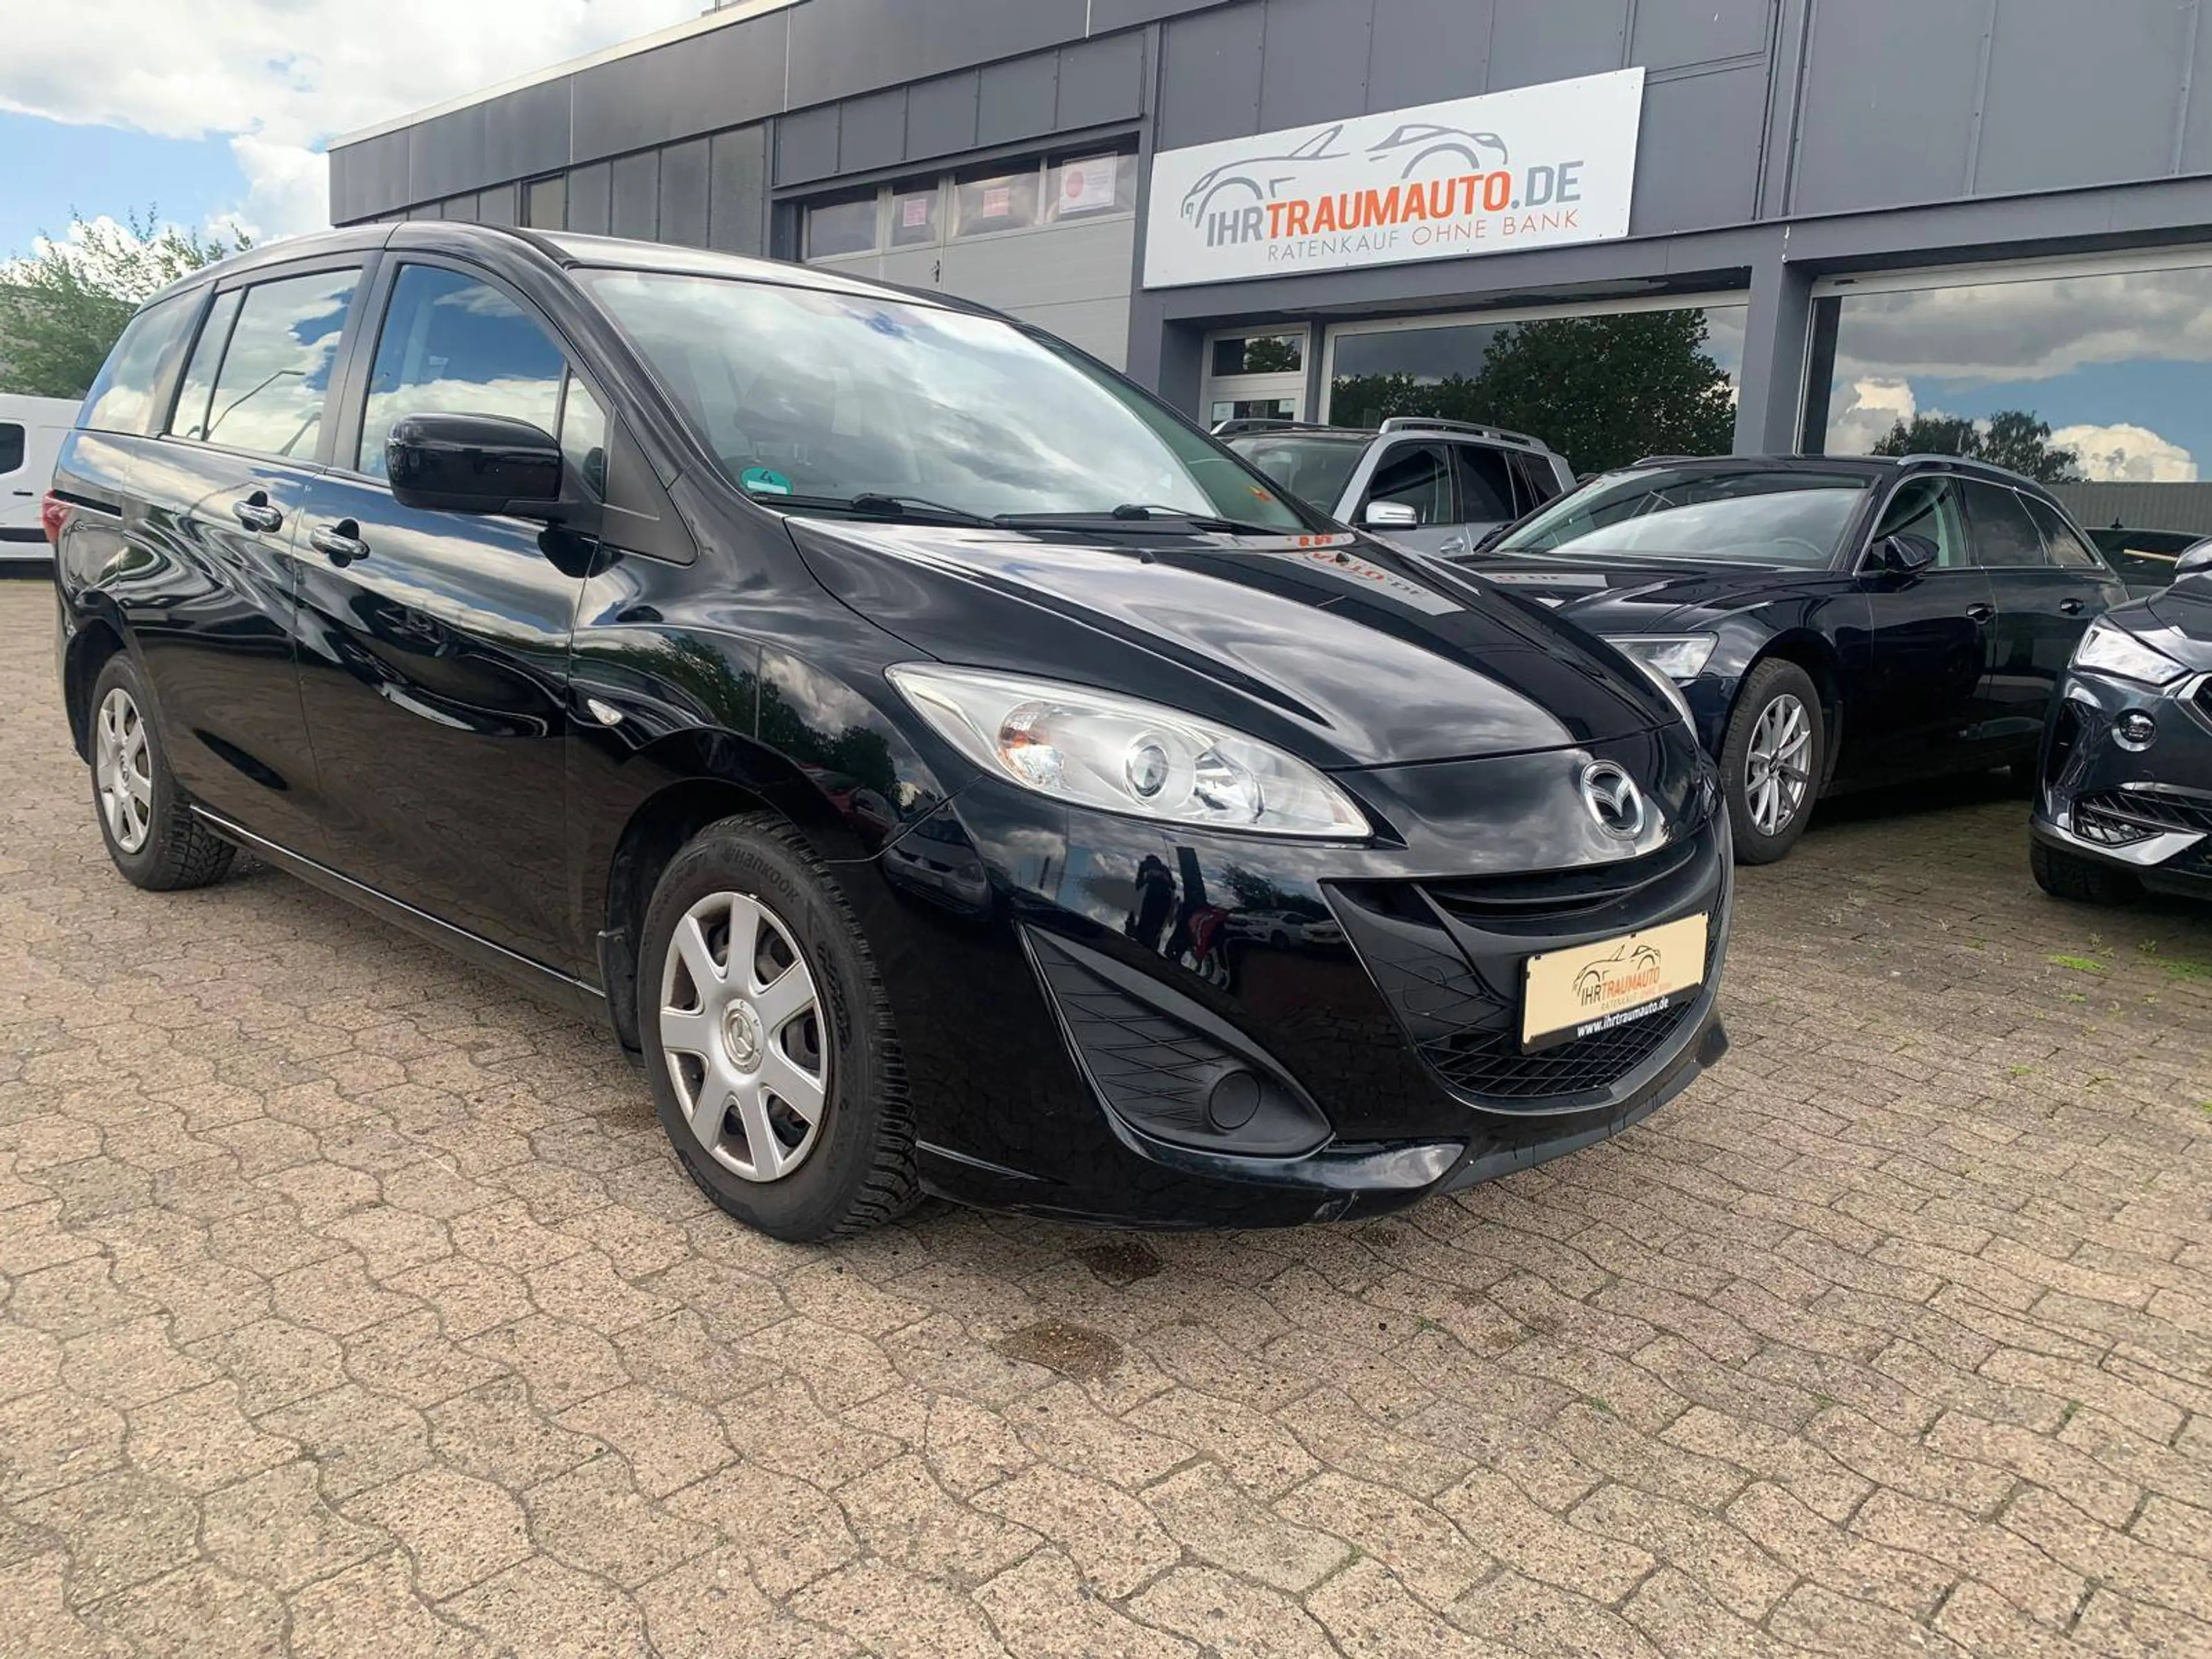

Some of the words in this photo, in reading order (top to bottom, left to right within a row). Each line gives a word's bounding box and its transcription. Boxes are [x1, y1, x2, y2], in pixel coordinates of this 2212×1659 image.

[1206, 160, 1584, 247] IHRTRAUMAUTO.DE
[1268, 230, 1399, 262] RATENKAUF
[1412, 219, 1487, 245] OHNE
[1502, 208, 1579, 236] BANK
[1577, 995, 1669, 1037] www.ihrtraumauto.de
